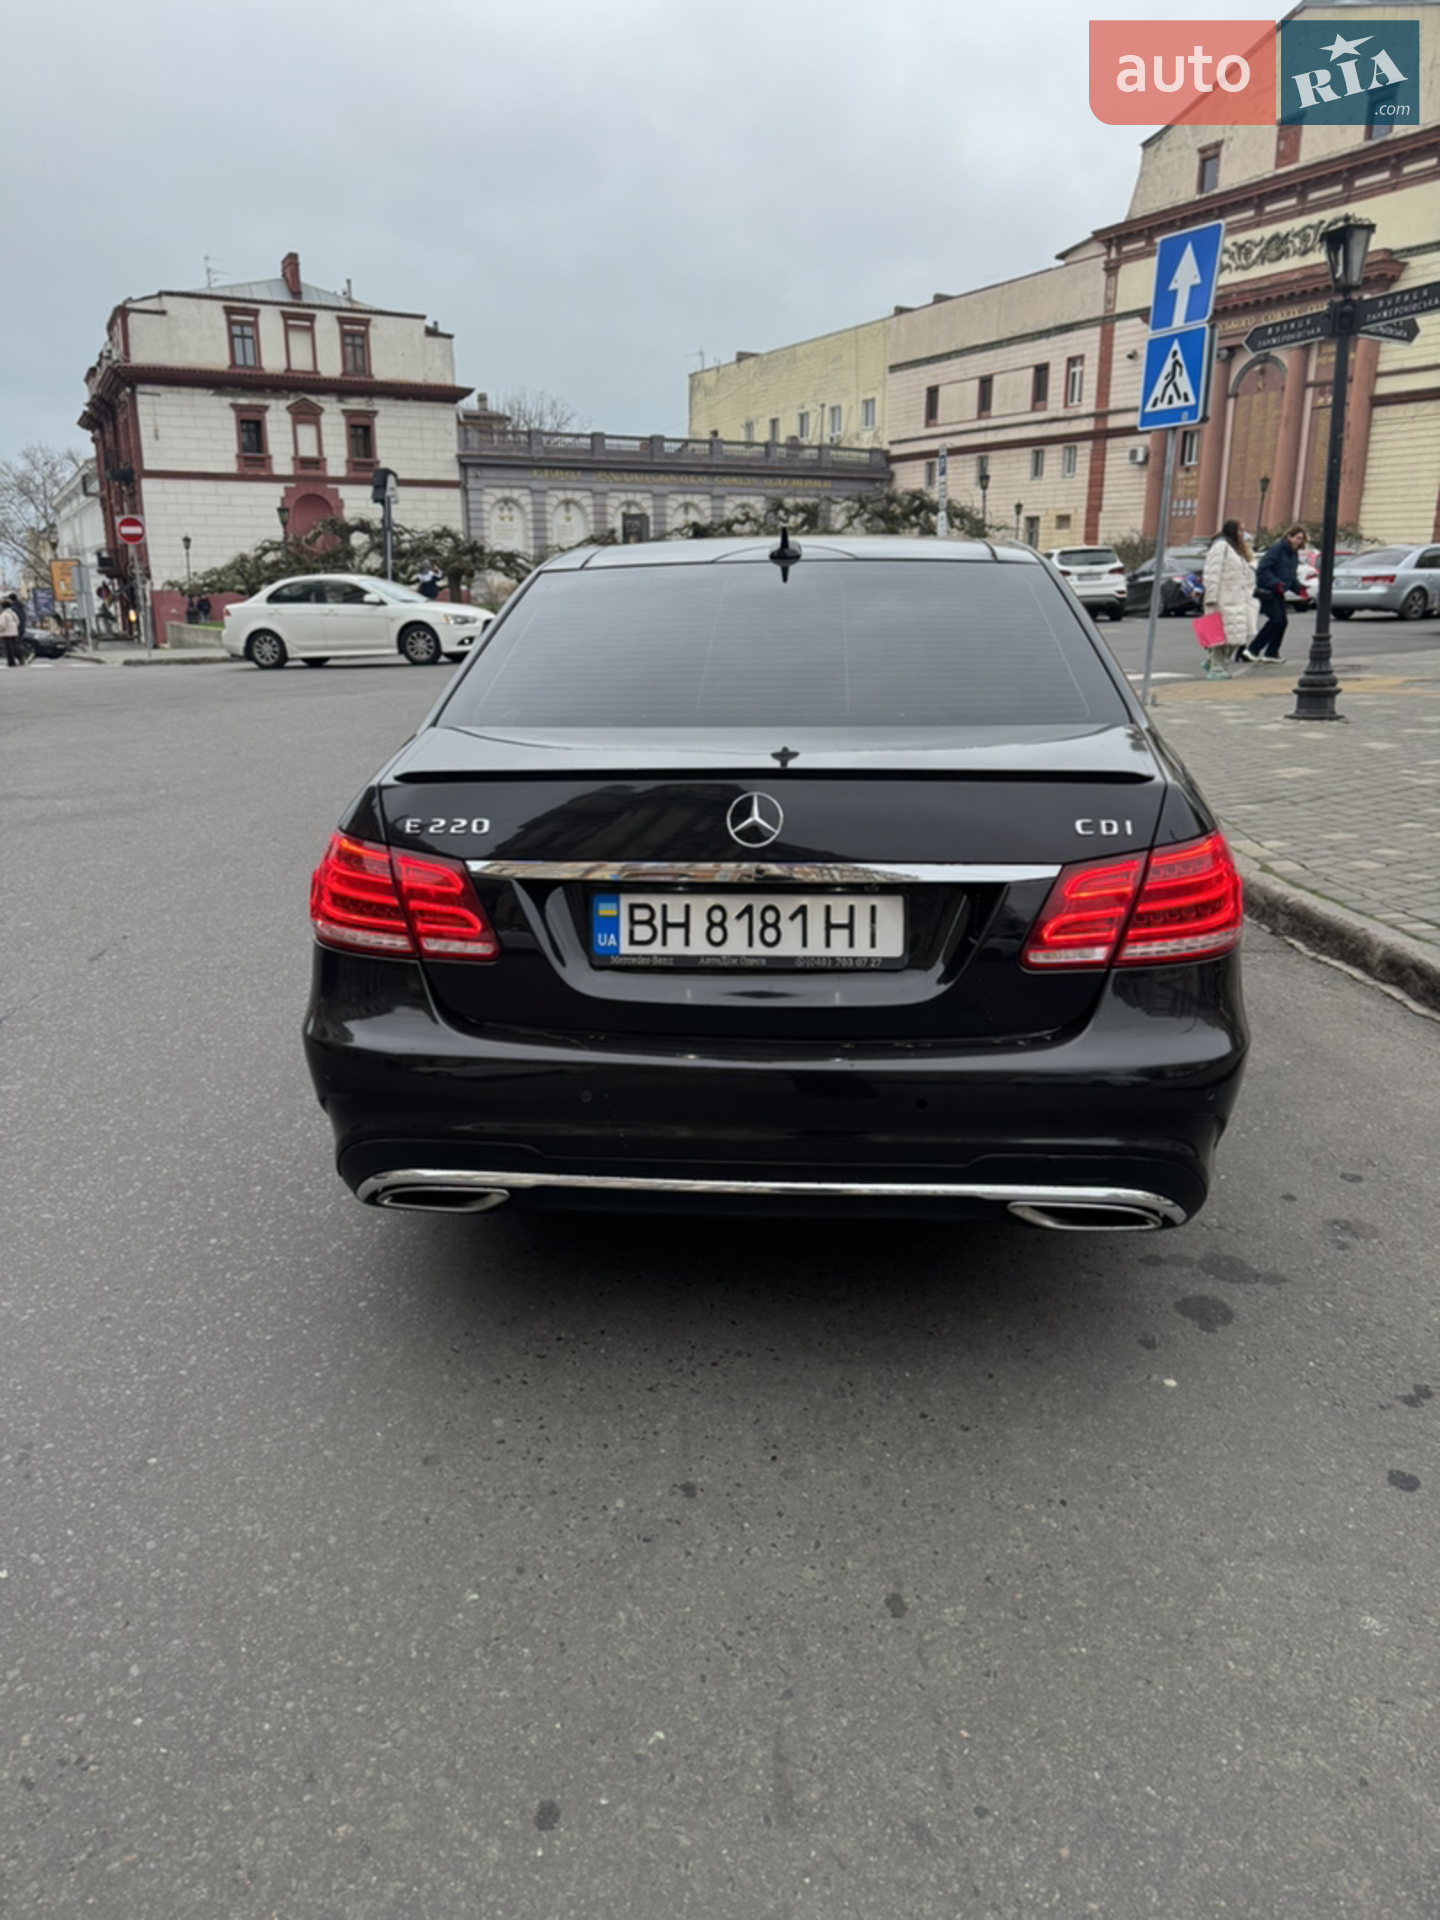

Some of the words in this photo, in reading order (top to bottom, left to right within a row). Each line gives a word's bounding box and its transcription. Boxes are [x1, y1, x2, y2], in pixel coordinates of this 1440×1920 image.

[405, 818, 421, 834] E
[428, 817, 491, 834] 220
[1074, 818, 1133, 836] CDI
[628, 903, 691, 947] BH
[705, 904, 808, 948] 8181
[824, 904, 877, 949] HI
[597, 933, 618, 947] UA
